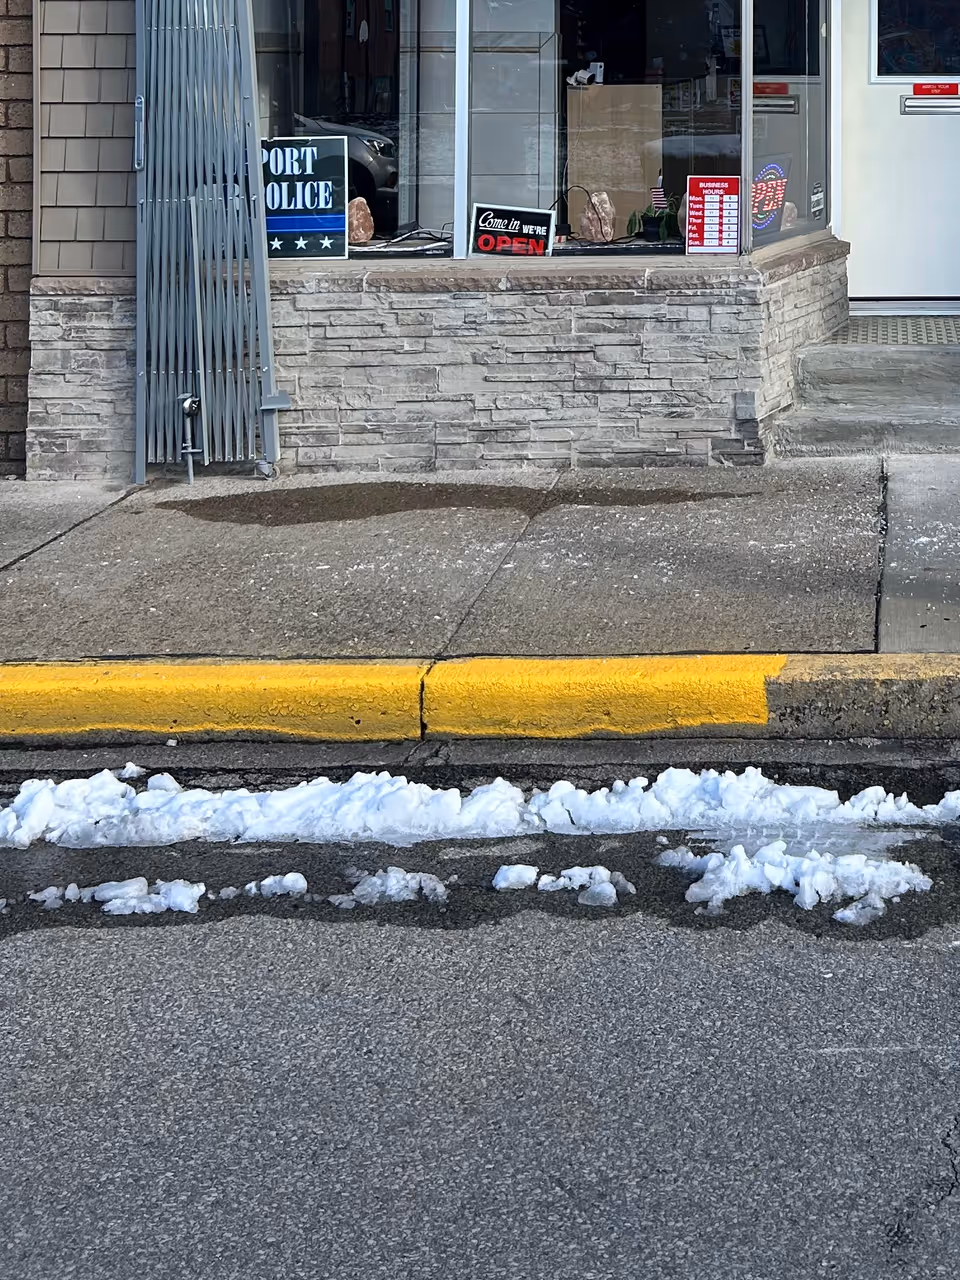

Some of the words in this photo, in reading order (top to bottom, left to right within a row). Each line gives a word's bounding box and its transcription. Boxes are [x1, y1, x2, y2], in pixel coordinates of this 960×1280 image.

[265, 180, 333, 210] OLICE
[478, 211, 508, 229] Come
[508, 218, 521, 230] in
[522, 224, 548, 236] WE'RE
[477, 234, 545, 257] OPEN
